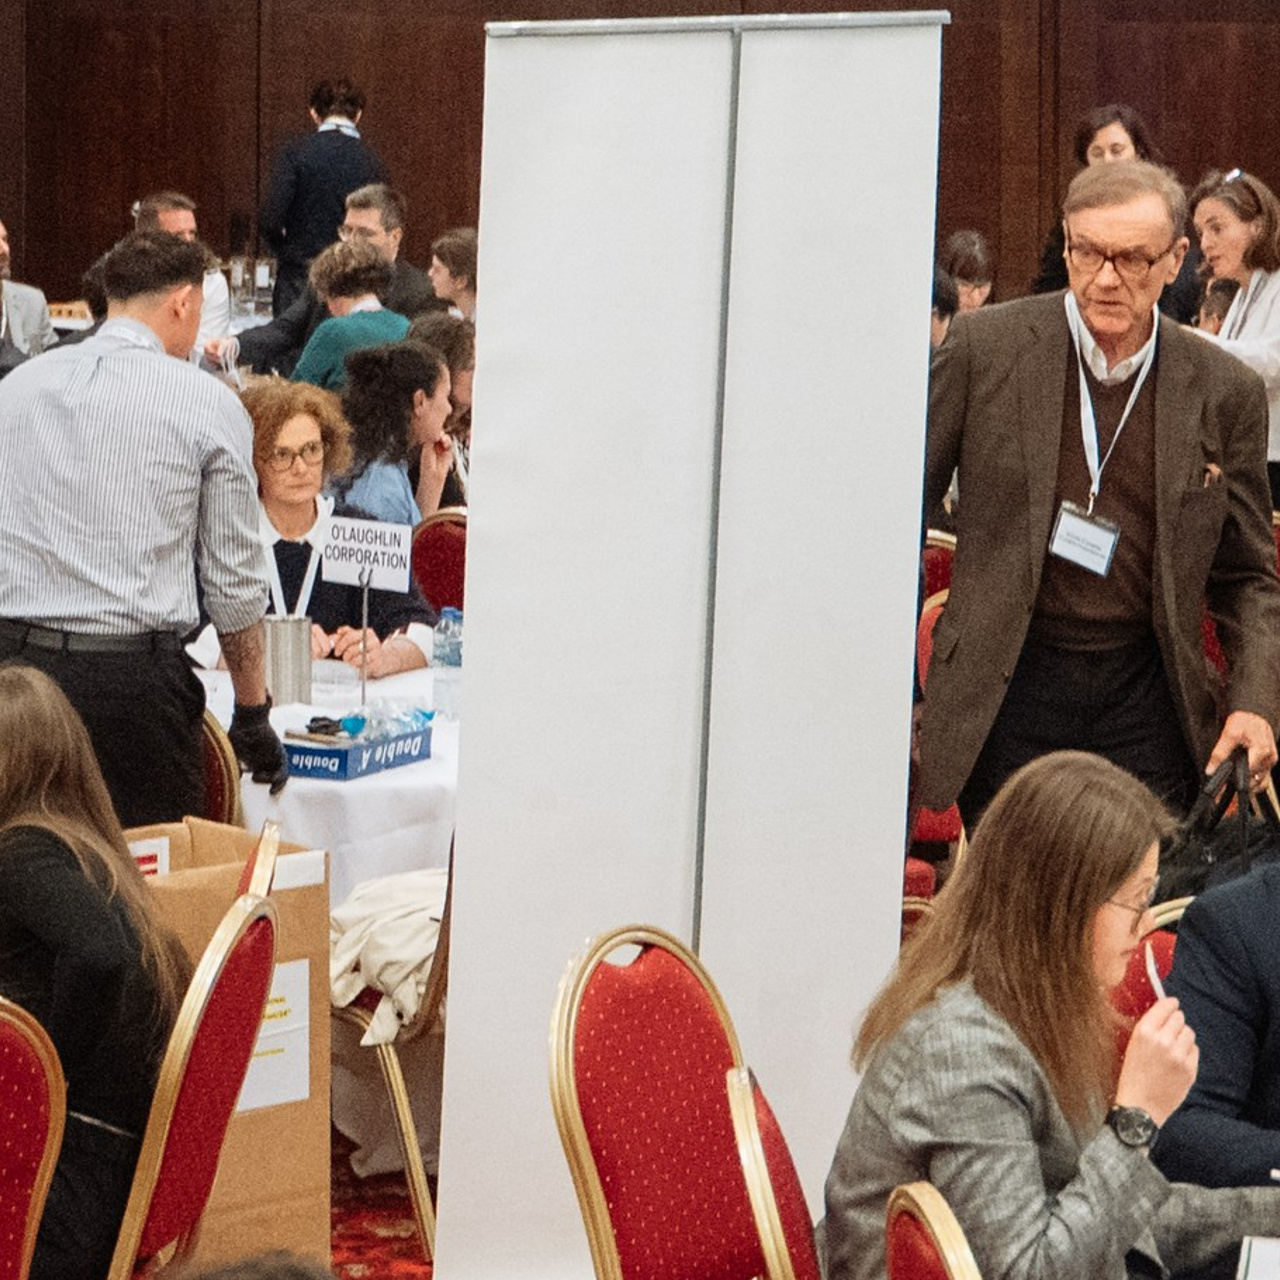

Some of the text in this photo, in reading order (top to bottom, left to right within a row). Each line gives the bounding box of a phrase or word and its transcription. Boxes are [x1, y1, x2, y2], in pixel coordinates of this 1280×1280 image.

[331, 524, 402, 548] O'LAUGHLIN
[324, 544, 408, 571] CORPORATION
[292, 753, 340, 772] Double
[375, 735, 422, 765] Double
